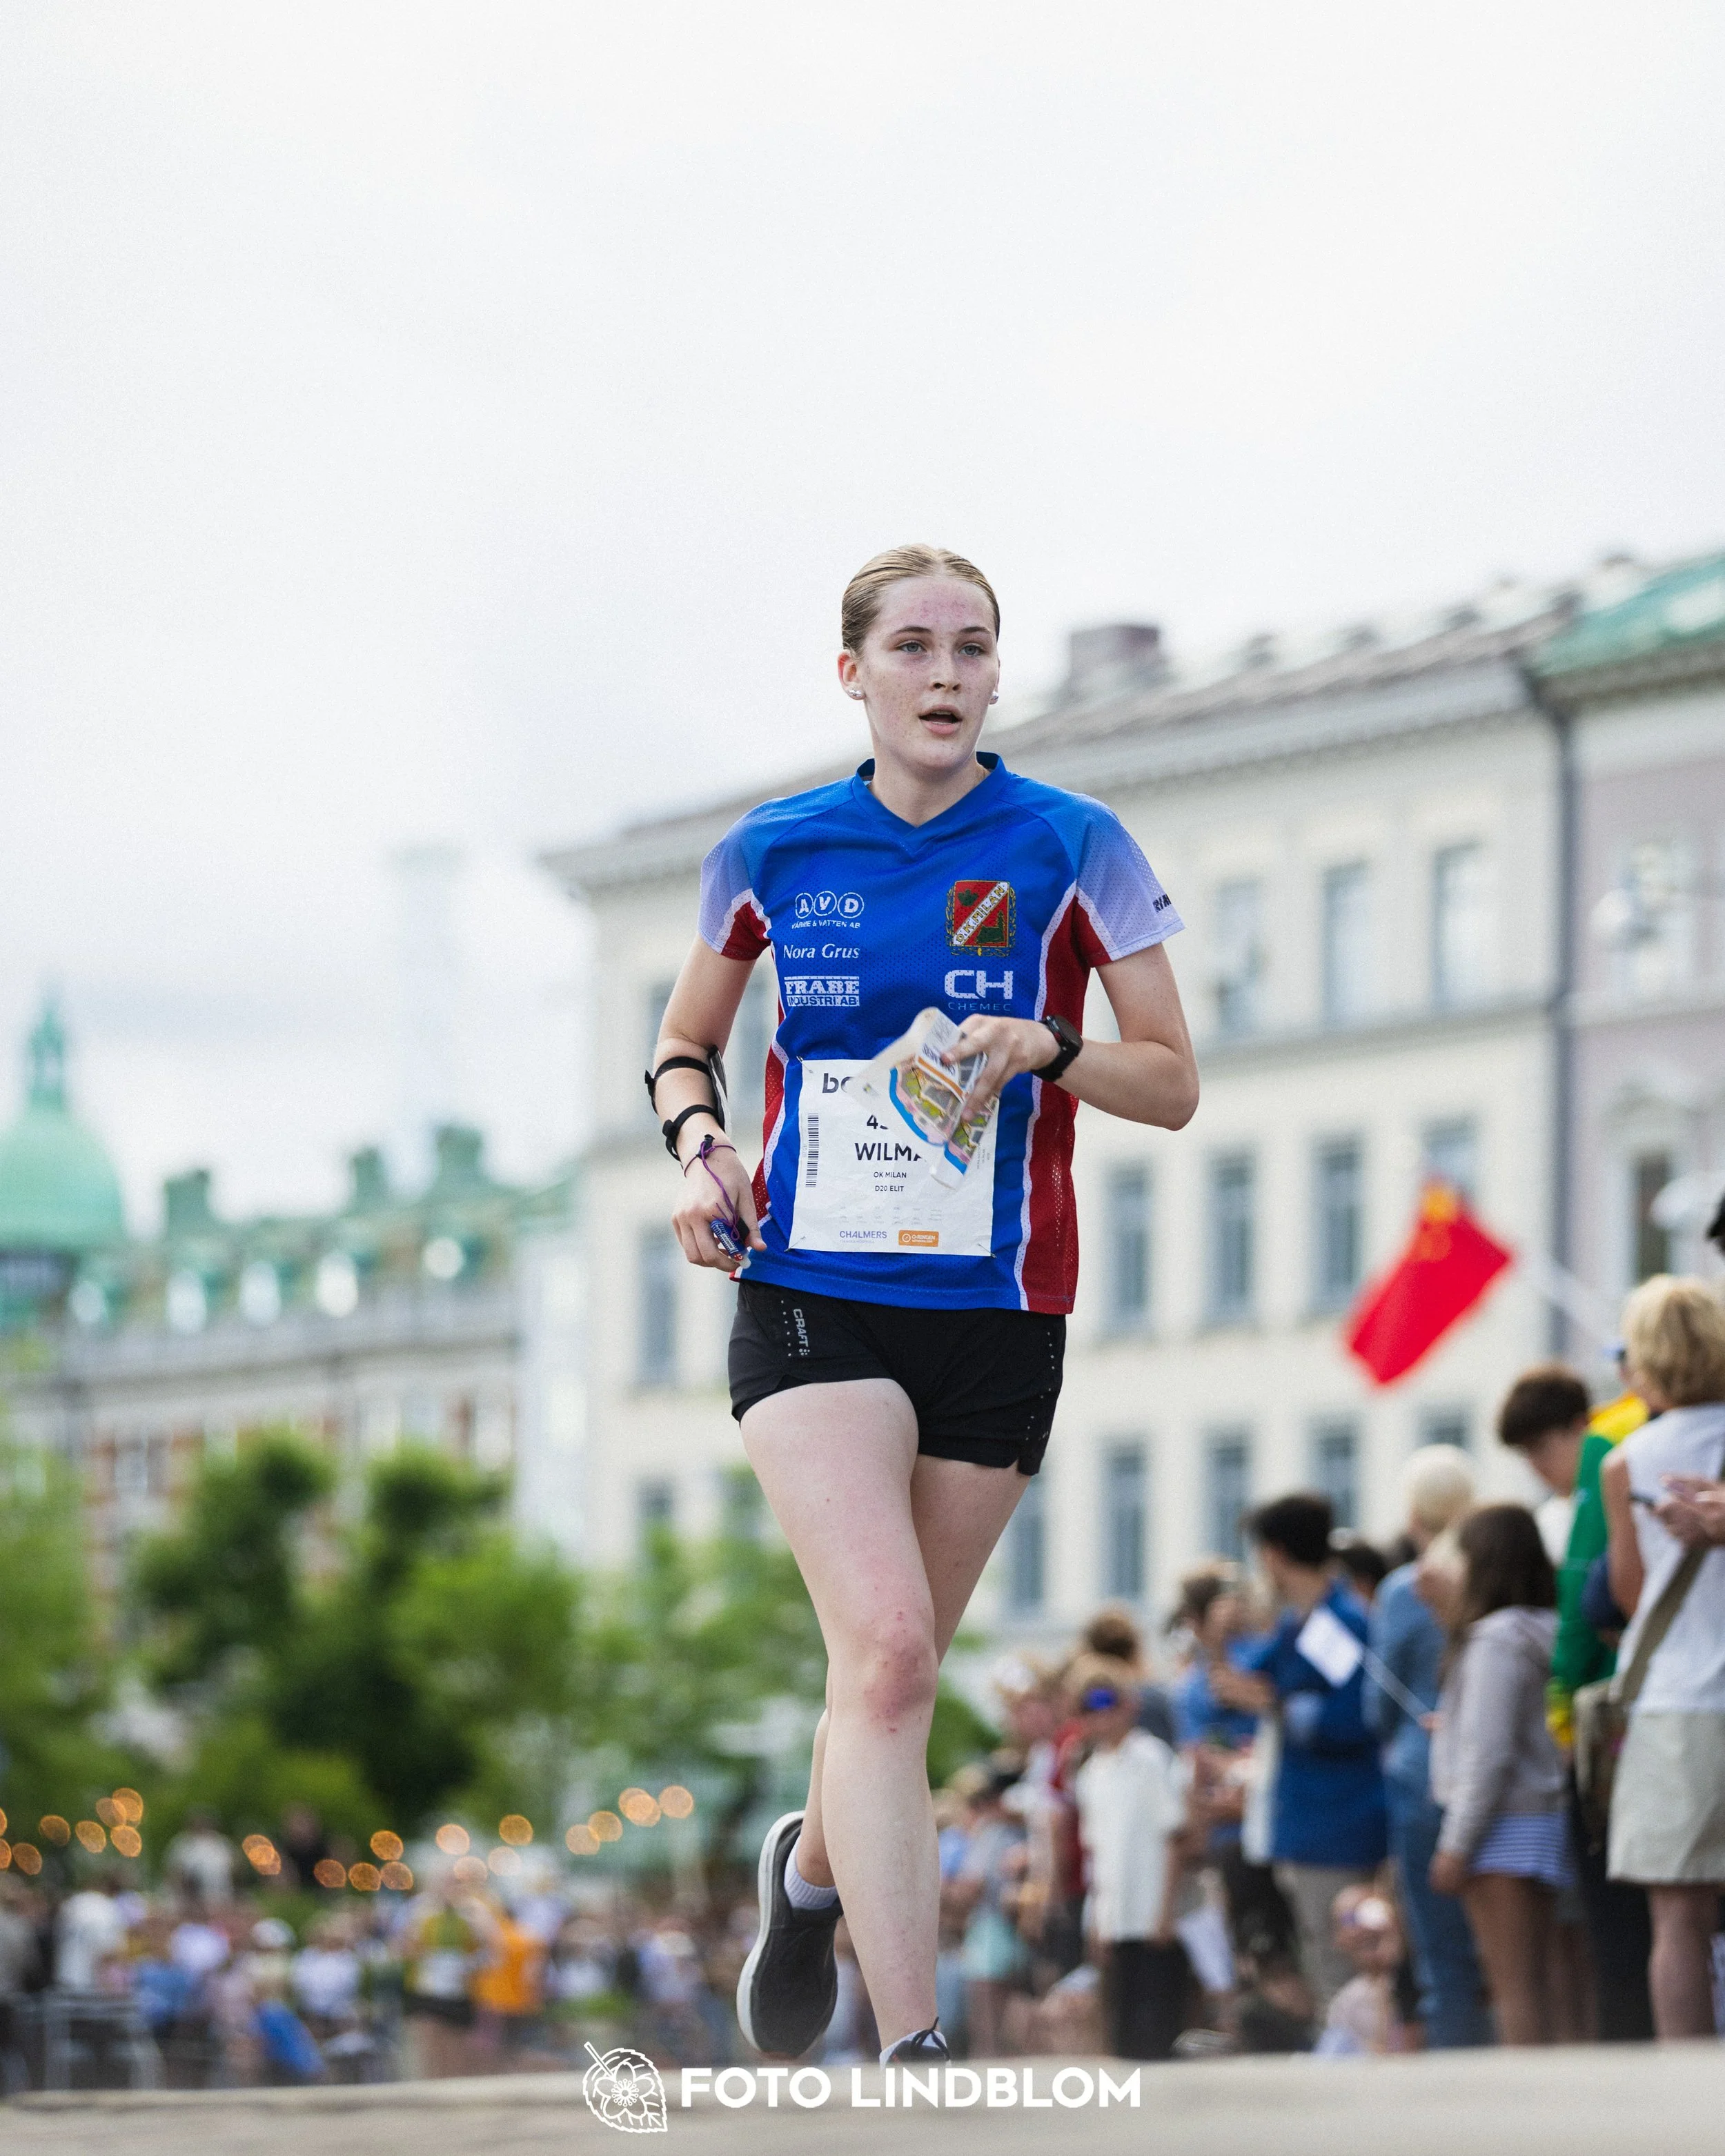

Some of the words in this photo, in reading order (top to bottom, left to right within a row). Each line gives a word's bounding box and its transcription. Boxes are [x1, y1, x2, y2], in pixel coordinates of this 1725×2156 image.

[973, 885, 1005, 922] MILAN
[784, 945, 816, 959] Nora
[822, 943, 860, 959] Grus
[785, 980, 860, 994] FRABE
[944, 969, 1014, 1000] CH
[789, 996, 836, 1006] INDUSTRI
[840, 996, 857, 1006] AB
[948, 1002, 1011, 1011] CHEMEC
[867, 1115, 889, 1129] 4
[793, 1309, 809, 1347] CRAFT
